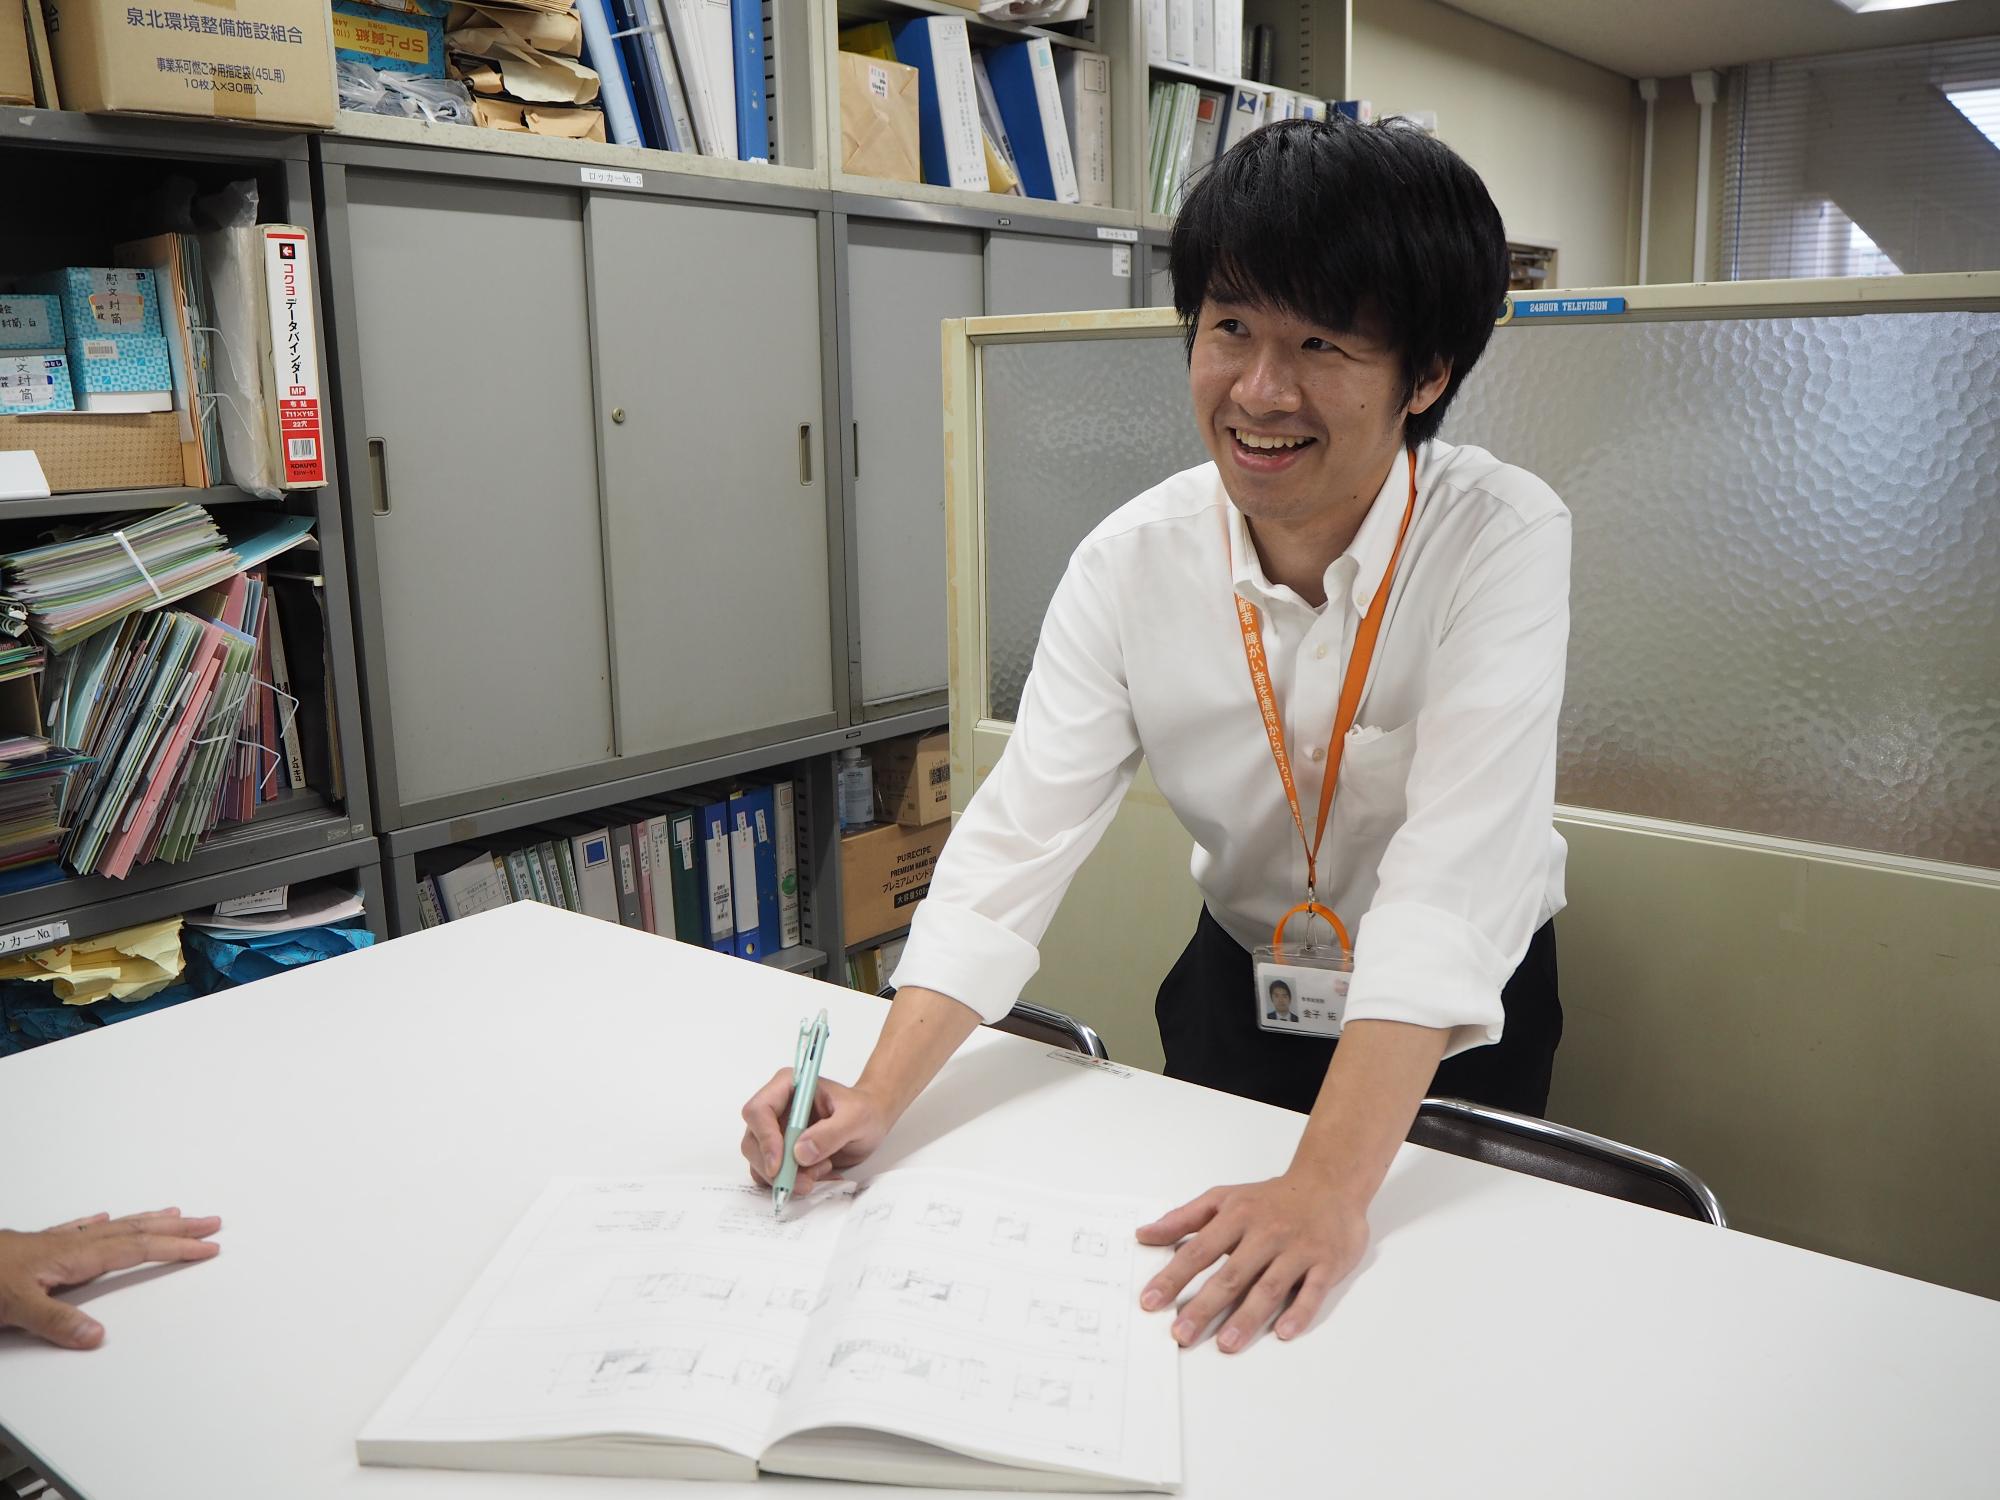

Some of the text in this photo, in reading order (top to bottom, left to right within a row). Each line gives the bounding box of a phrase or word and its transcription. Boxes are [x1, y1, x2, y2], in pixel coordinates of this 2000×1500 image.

[127, 8, 303, 44] 泉北環境整備施設組合
[1530, 301, 1608, 313] 24HOUR TELEVISION
[283, 263, 301, 384] コクヨ データバインダー
[291, 387, 304, 396] MP
[896, 846, 932, 863] PURECIPE
[890, 864, 915, 878] PREMIUM
